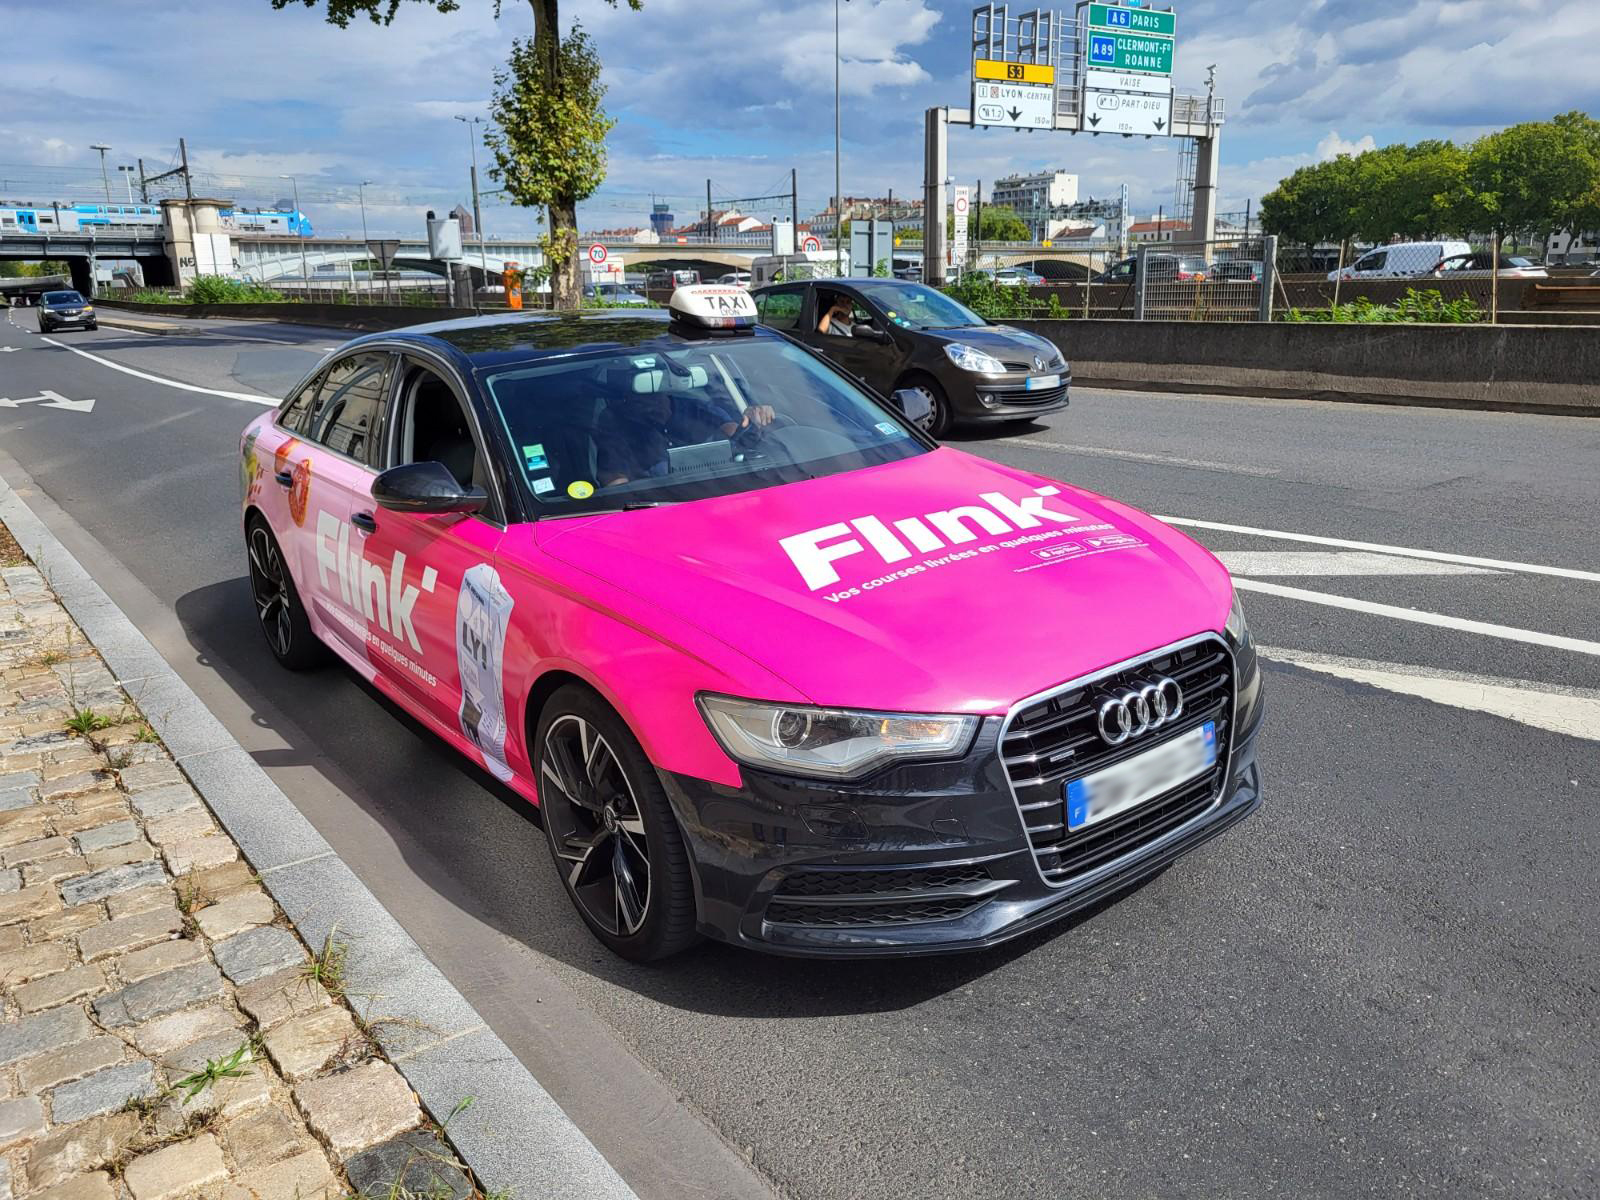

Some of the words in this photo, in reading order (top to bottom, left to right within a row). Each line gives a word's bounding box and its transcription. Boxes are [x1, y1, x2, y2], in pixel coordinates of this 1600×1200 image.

[1112, 11, 1126, 25] A6
[1132, 14, 1159, 29] PARIS
[1125, 53, 1162, 68] ROANNE
[1120, 77, 1141, 88] VAISE
[593, 250, 604, 258] 70
[704, 296, 747, 310] TAXI
[822, 587, 861, 603] Vos
[861, 564, 927, 590] courses
[923, 547, 979, 569] livrées
[977, 544, 1000, 553] en
[1000, 530, 1064, 548] quelques
[462, 621, 487, 670] LY!
[380, 640, 409, 668] quelques
[408, 660, 437, 687] minutes
